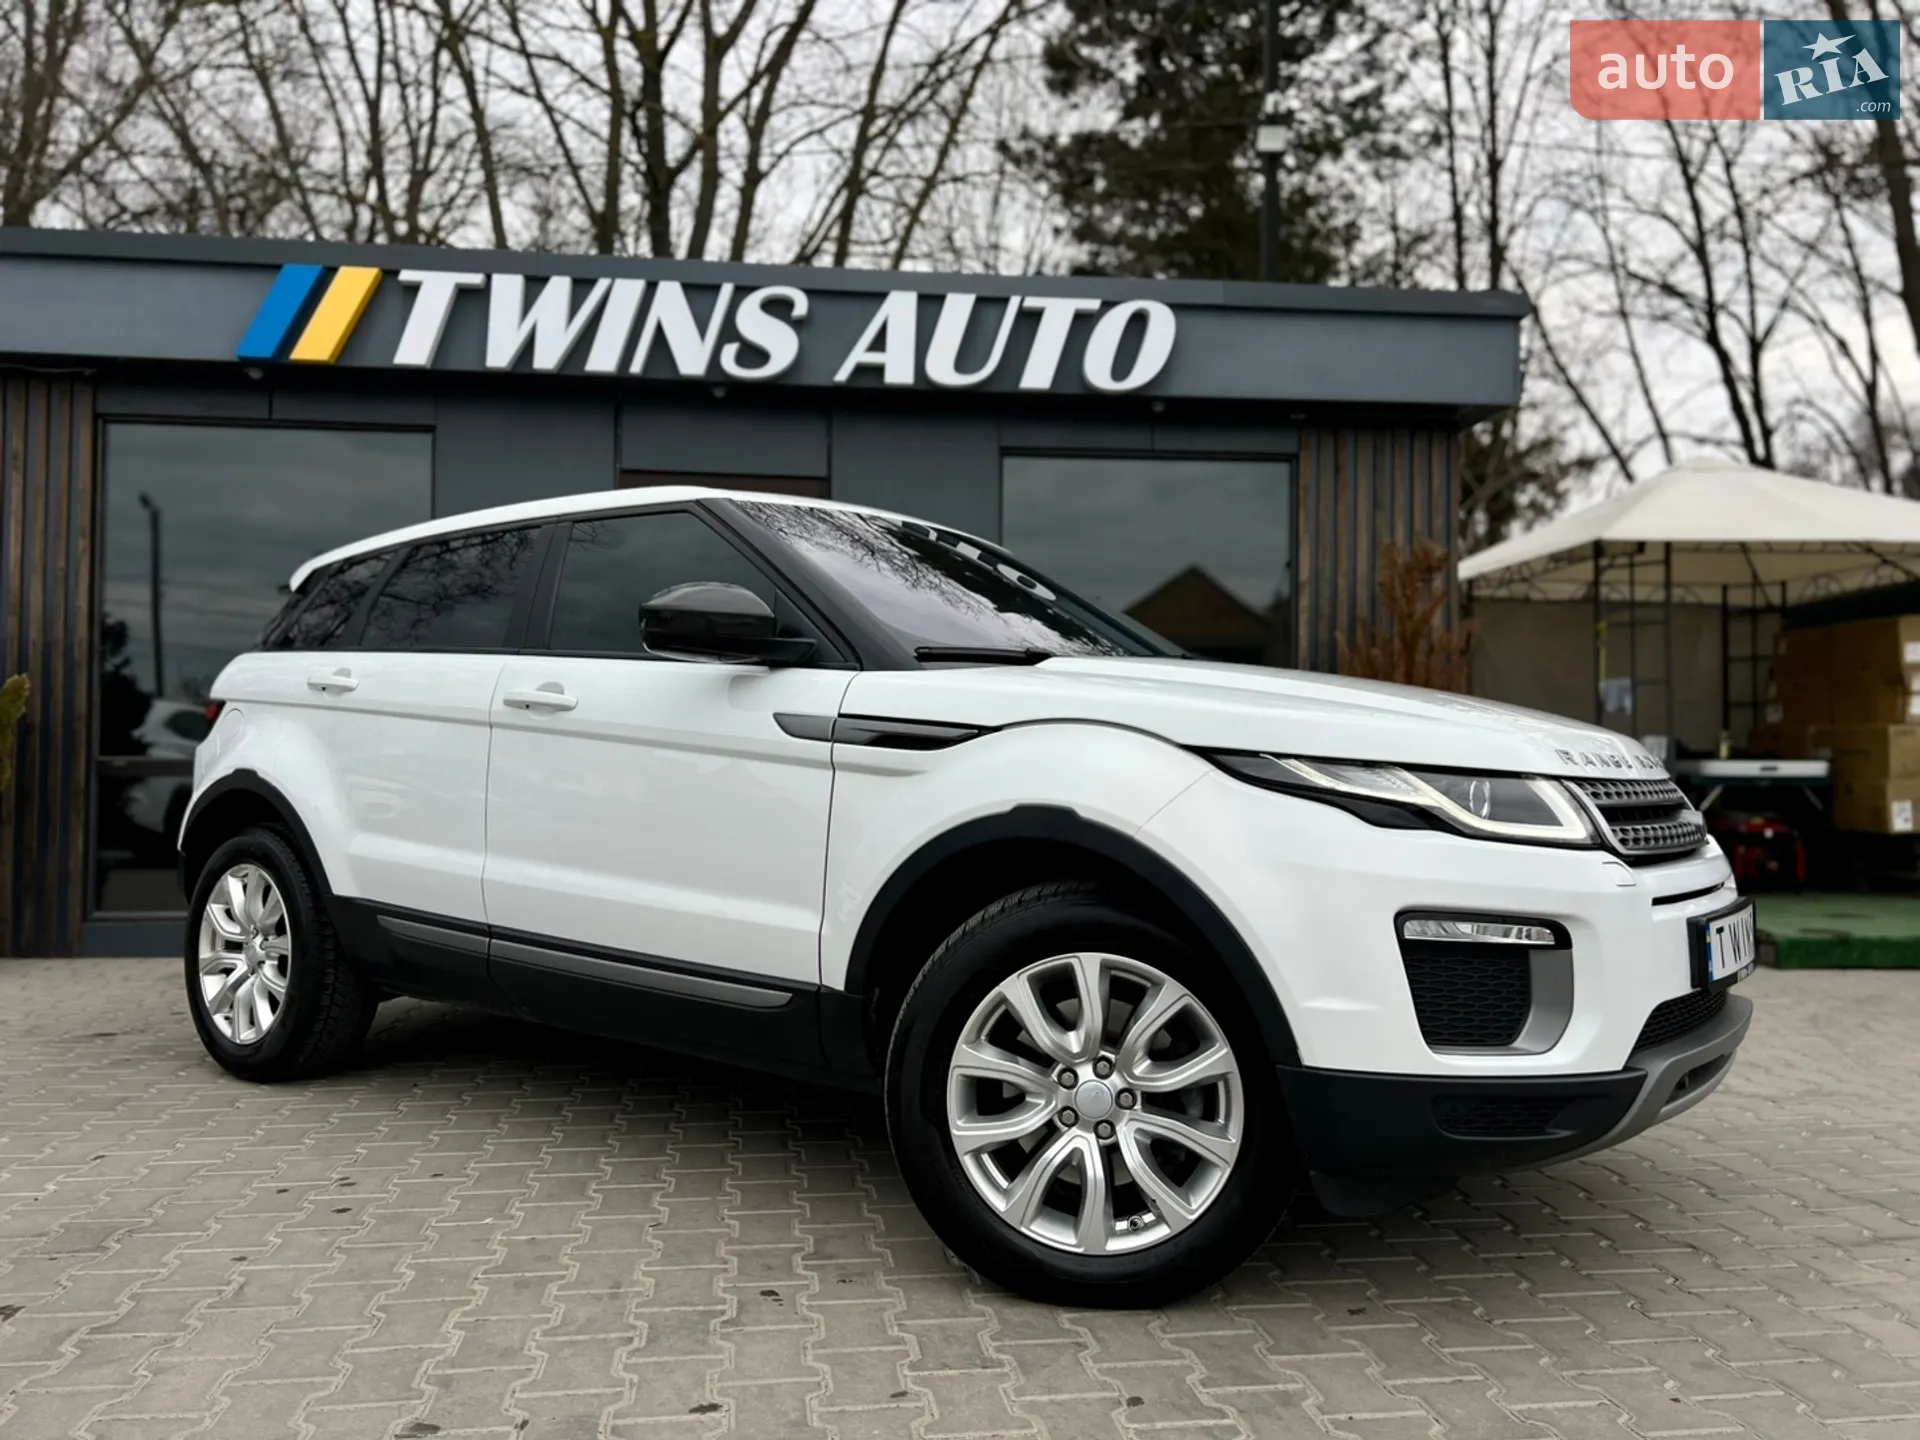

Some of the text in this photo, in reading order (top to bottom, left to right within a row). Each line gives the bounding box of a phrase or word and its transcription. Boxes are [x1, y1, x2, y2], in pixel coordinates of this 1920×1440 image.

[393, 269, 1176, 393] TWINS AUTO
[1555, 749, 1633, 769] RANGE
